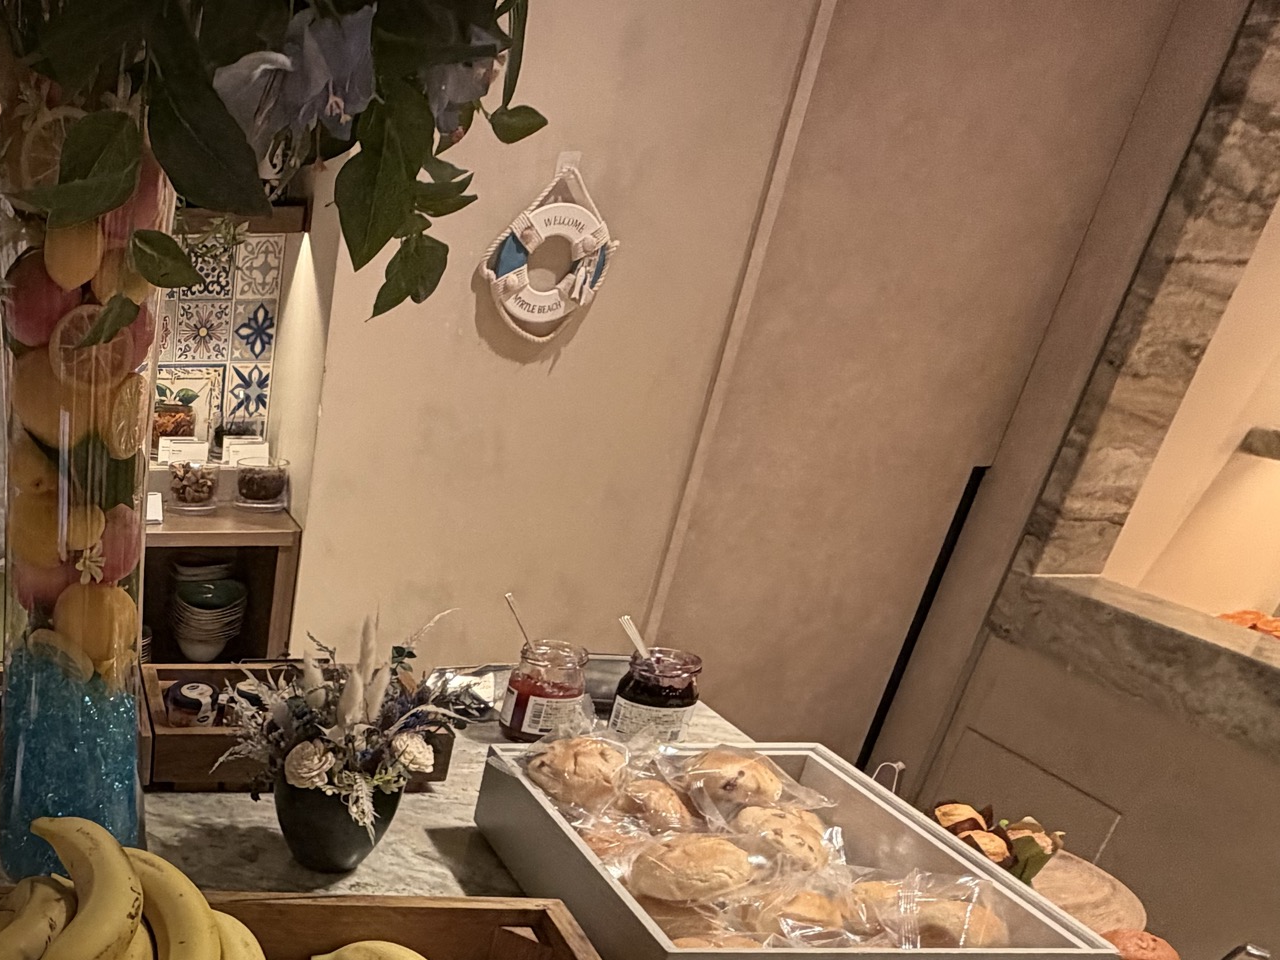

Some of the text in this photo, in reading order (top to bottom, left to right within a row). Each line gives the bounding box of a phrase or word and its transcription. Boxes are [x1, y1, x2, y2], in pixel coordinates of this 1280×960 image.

[543, 215, 586, 233] WELCOME
[513, 294, 562, 314] MYRTLE BEACH
